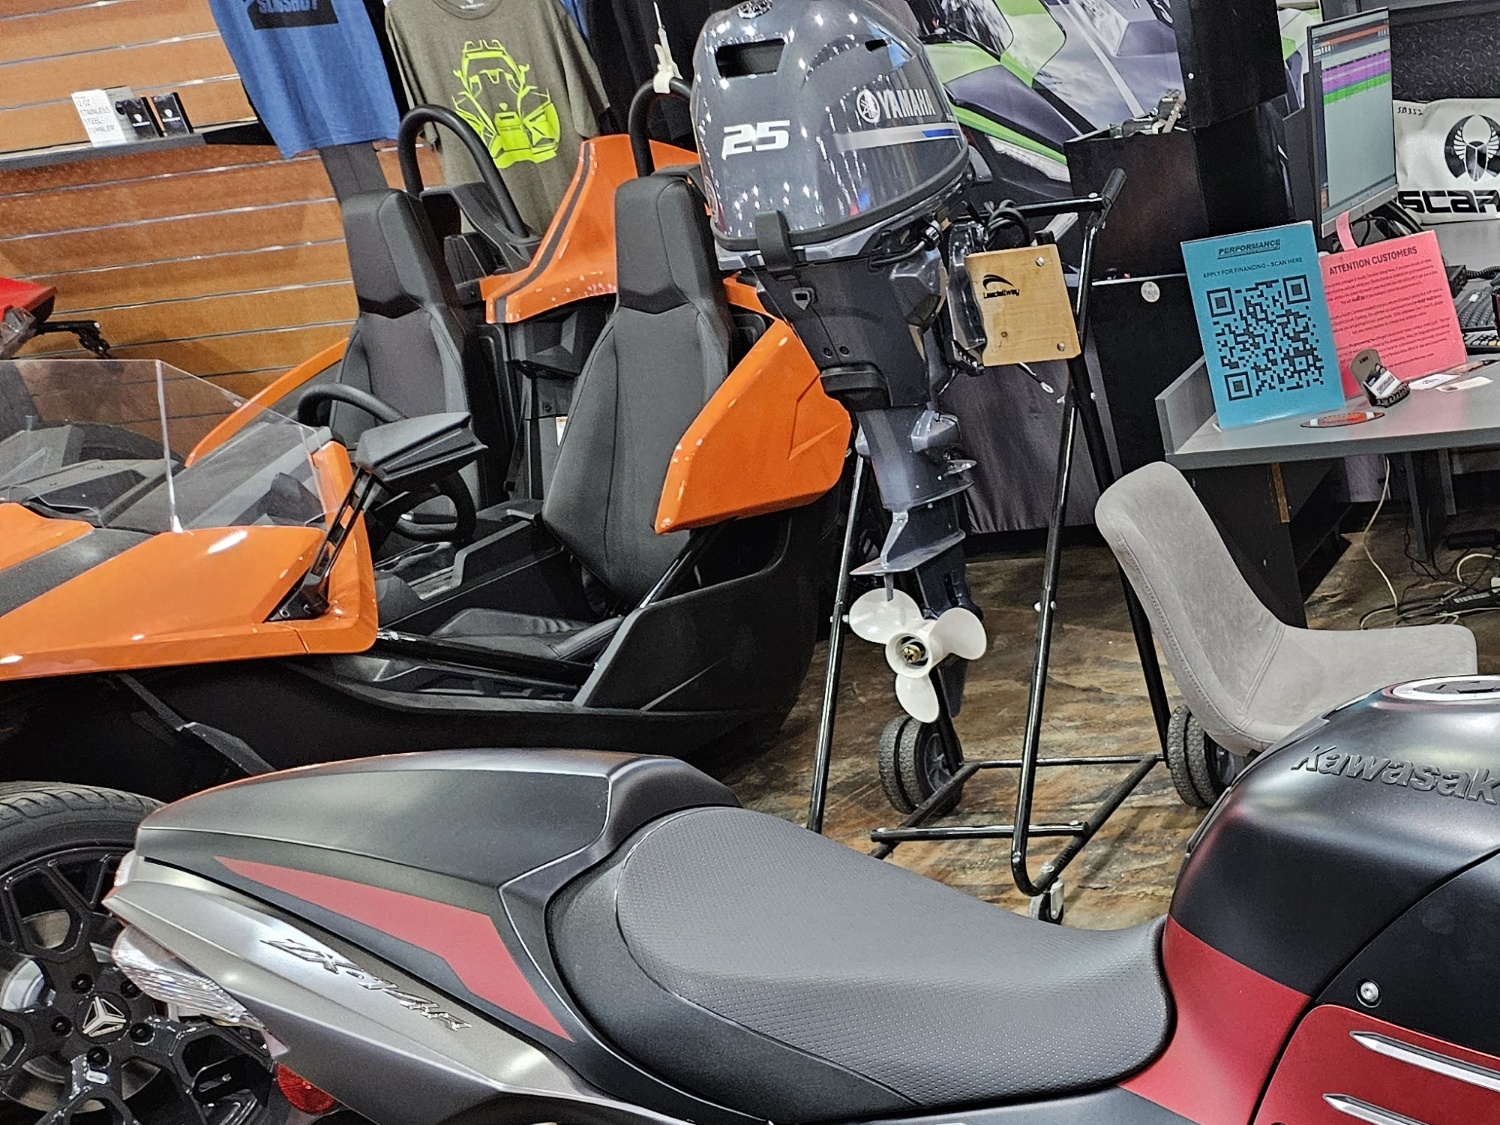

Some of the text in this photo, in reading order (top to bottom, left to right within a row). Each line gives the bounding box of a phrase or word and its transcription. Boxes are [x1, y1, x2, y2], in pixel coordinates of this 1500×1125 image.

[876, 88, 937, 119] YAMAHA
[721, 119, 791, 161] 25
[1218, 238, 1281, 255] PERFORMANCE
[1329, 246, 1418, 276] ATTENTION CUSTOMERS
[1203, 271, 1221, 279] APPLY
[1234, 263, 1266, 274] FINANCING
[1271, 260, 1287, 268] SCAN
